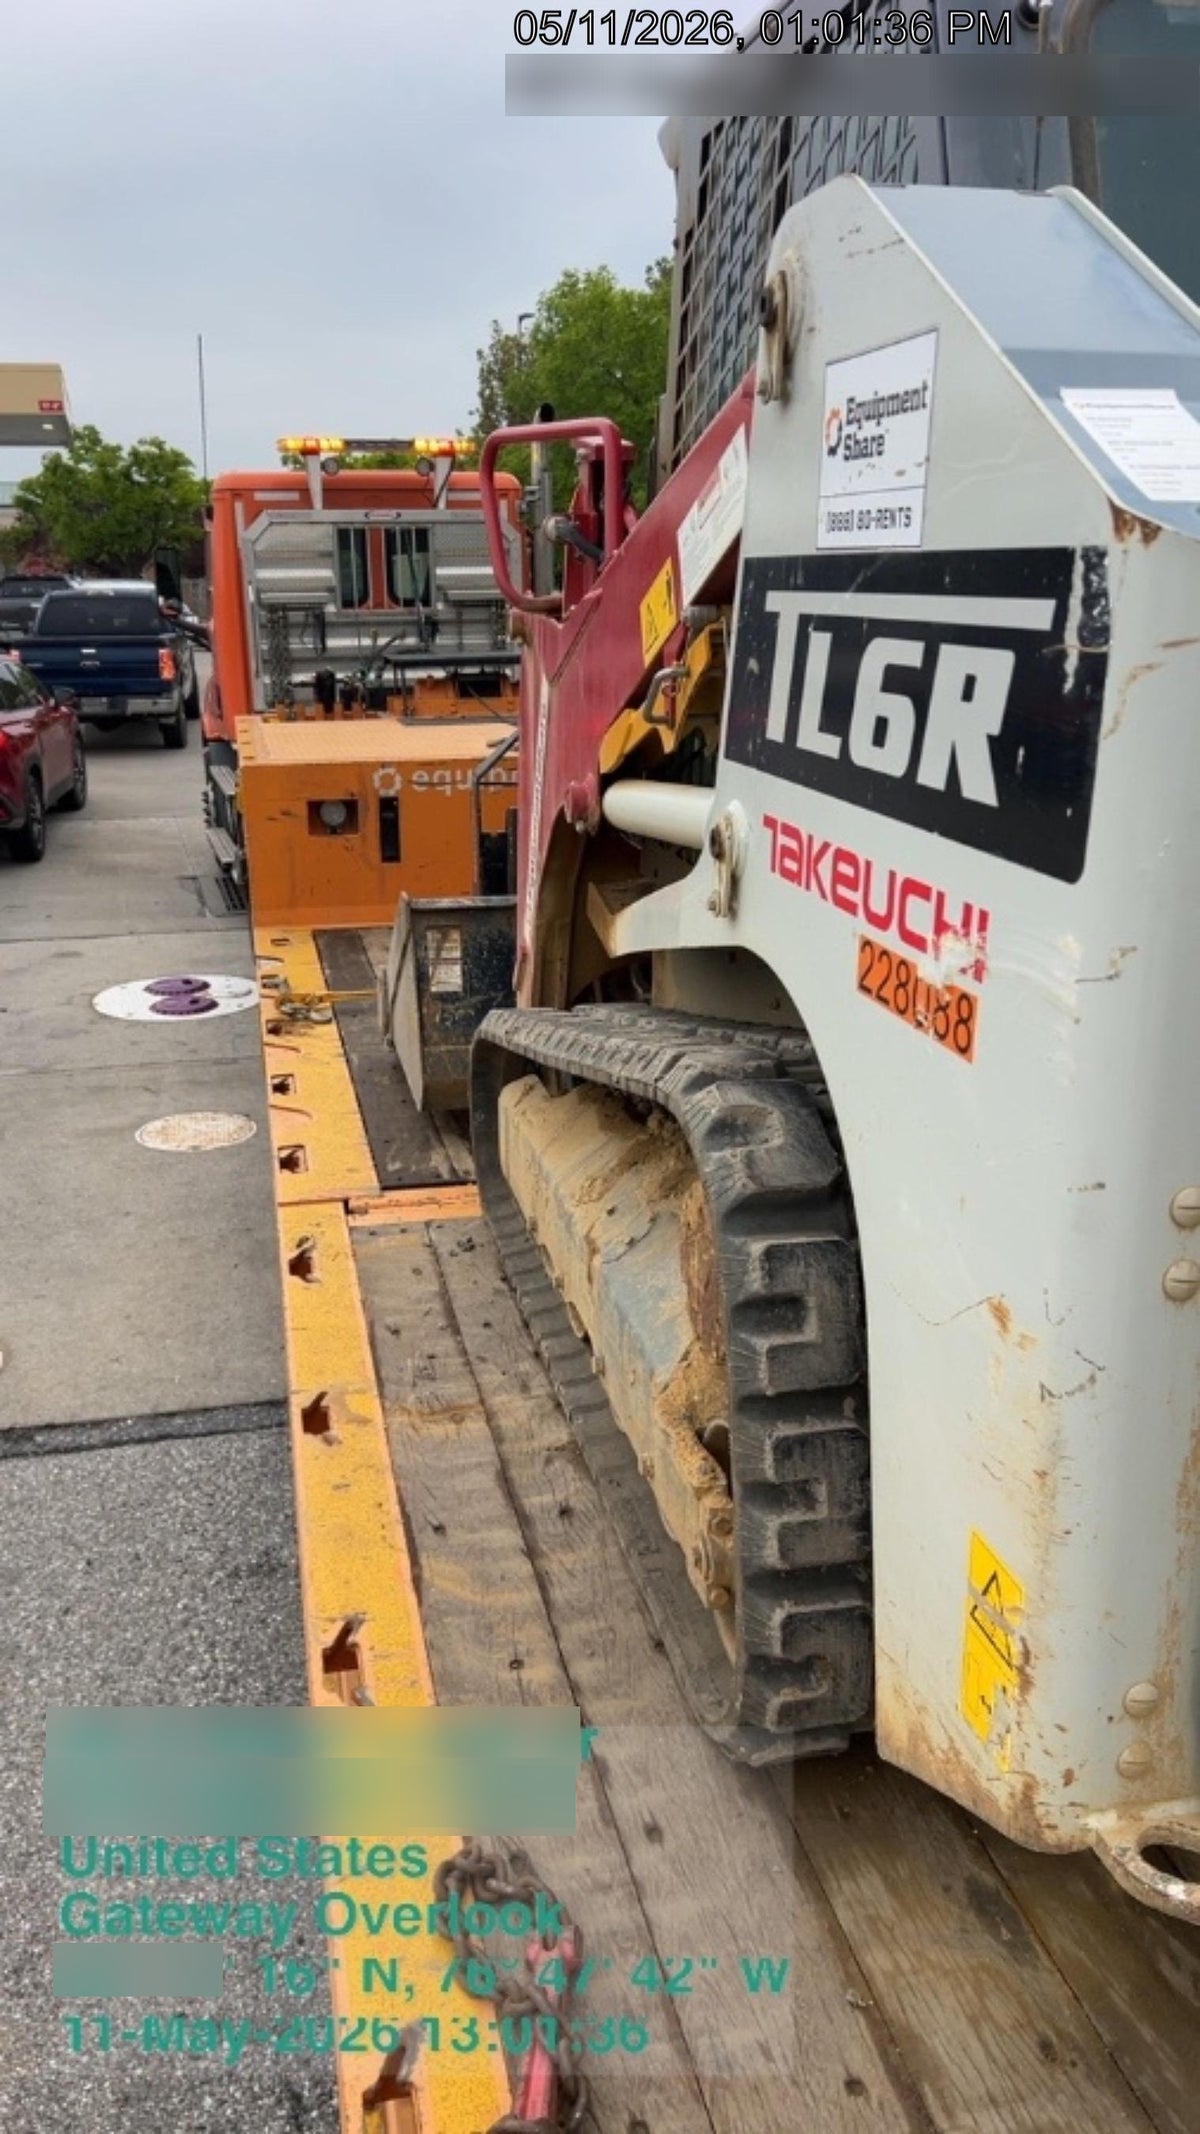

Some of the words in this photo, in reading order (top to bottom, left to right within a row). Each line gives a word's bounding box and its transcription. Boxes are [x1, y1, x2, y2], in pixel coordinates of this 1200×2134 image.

[845, 379, 928, 430] Equipment
[843, 432, 885, 461] Share
[764, 589, 1057, 809] TL6R
